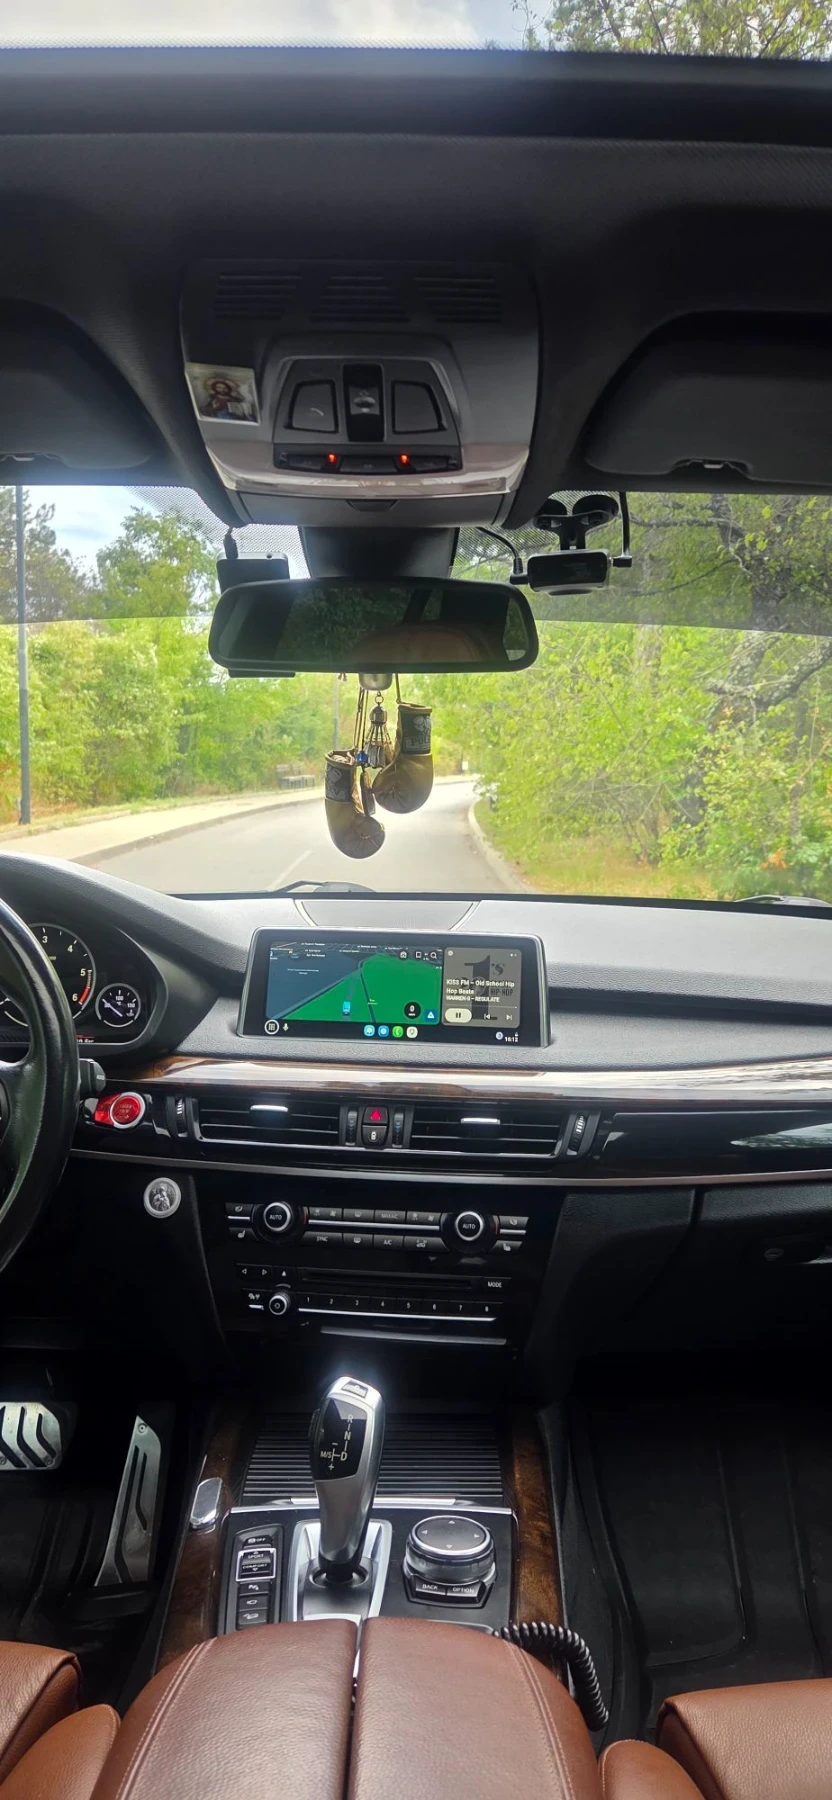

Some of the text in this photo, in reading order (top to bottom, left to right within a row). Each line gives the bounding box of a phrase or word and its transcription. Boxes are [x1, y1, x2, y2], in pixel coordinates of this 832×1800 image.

[347, 1414, 353, 1423] R
[344, 1431, 351, 1440] N
[320, 1451, 348, 1461] M/S D
